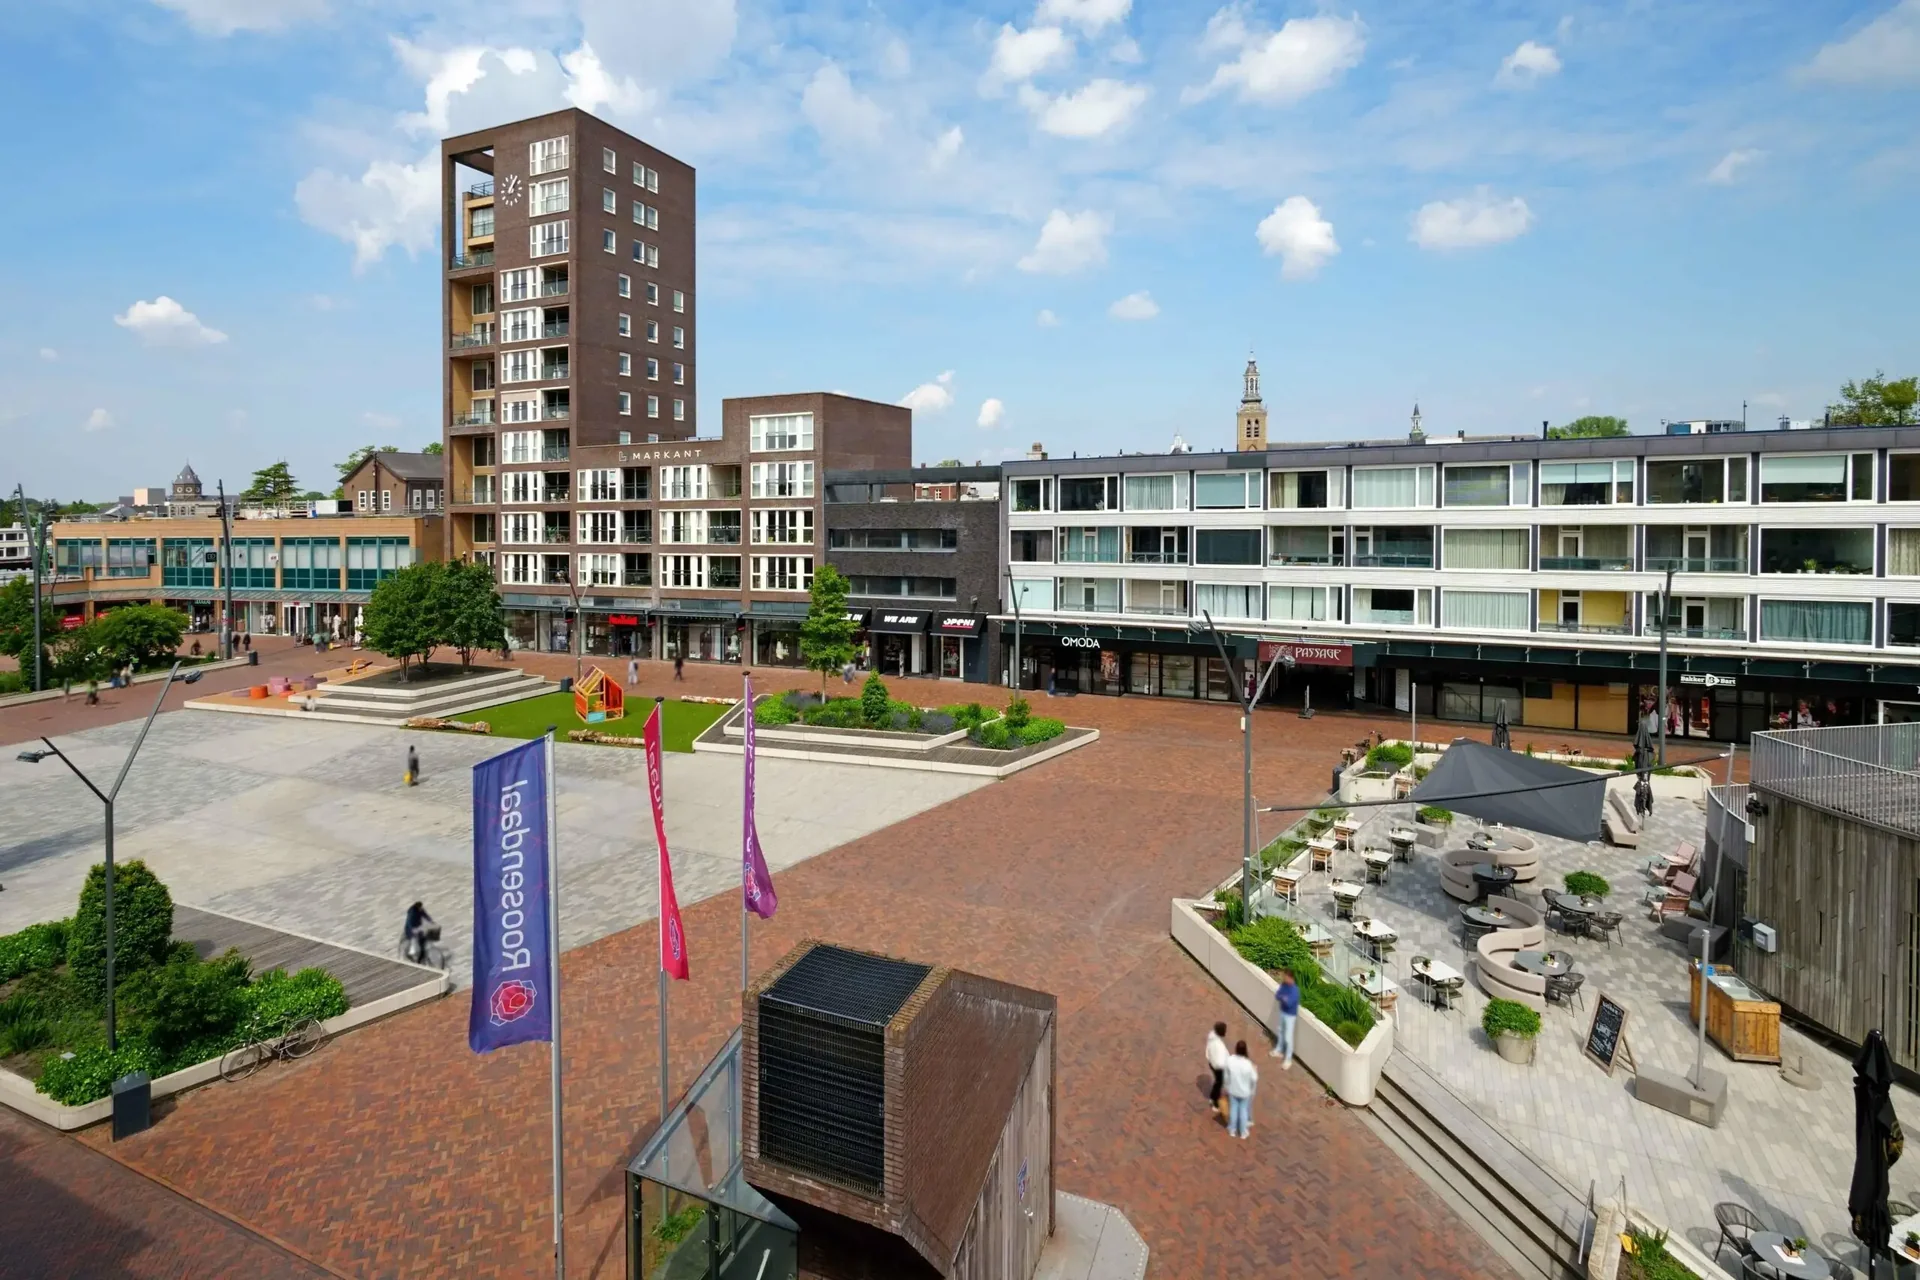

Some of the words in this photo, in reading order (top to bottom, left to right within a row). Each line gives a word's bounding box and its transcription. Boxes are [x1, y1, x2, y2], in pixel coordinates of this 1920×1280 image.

[632, 449, 702, 460] MARKANT
[883, 615, 899, 623] WE
[898, 616, 918, 624] ARE
[1061, 636, 1100, 649] OMODA
[1295, 646, 1342, 661] PASSAGE
[1680, 675, 1705, 683] Bakker
